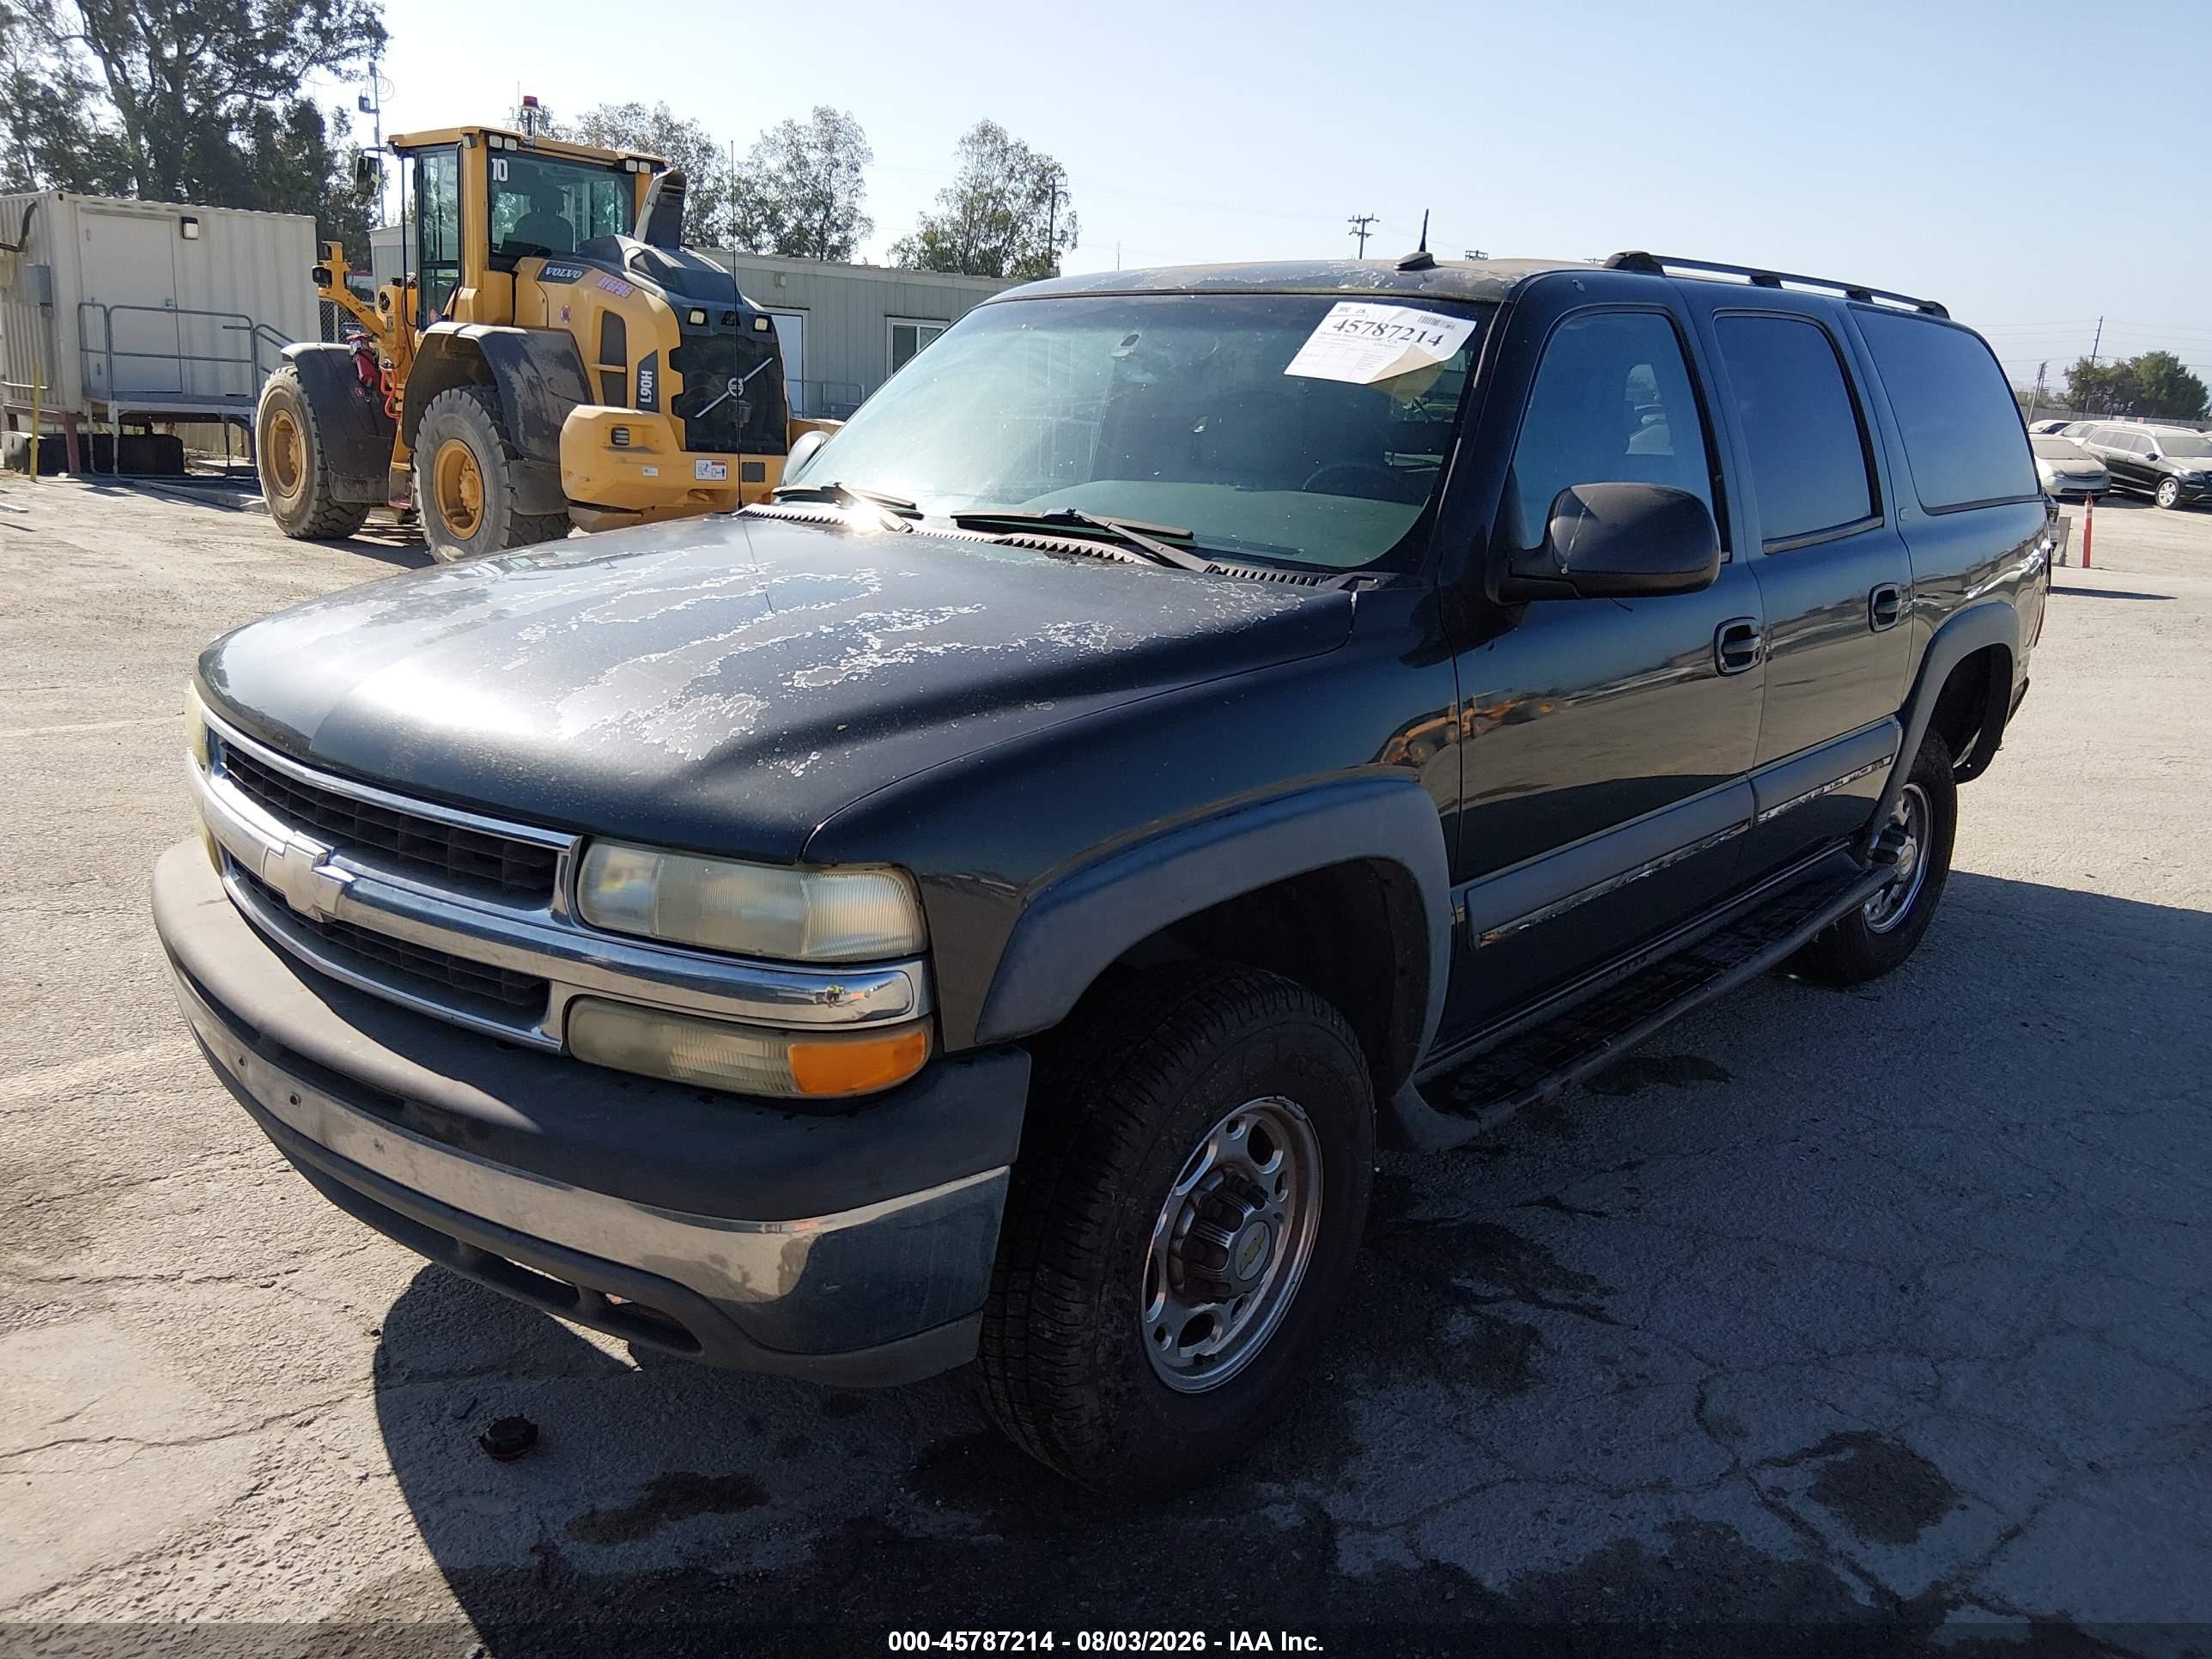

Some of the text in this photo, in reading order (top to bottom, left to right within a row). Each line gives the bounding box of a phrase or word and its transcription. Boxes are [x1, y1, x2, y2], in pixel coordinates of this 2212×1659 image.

[491, 158, 508, 182] 10
[545, 266, 583, 279] VOLVO
[1333, 318, 1444, 348] 45787214
[640, 370, 653, 404] L90H
